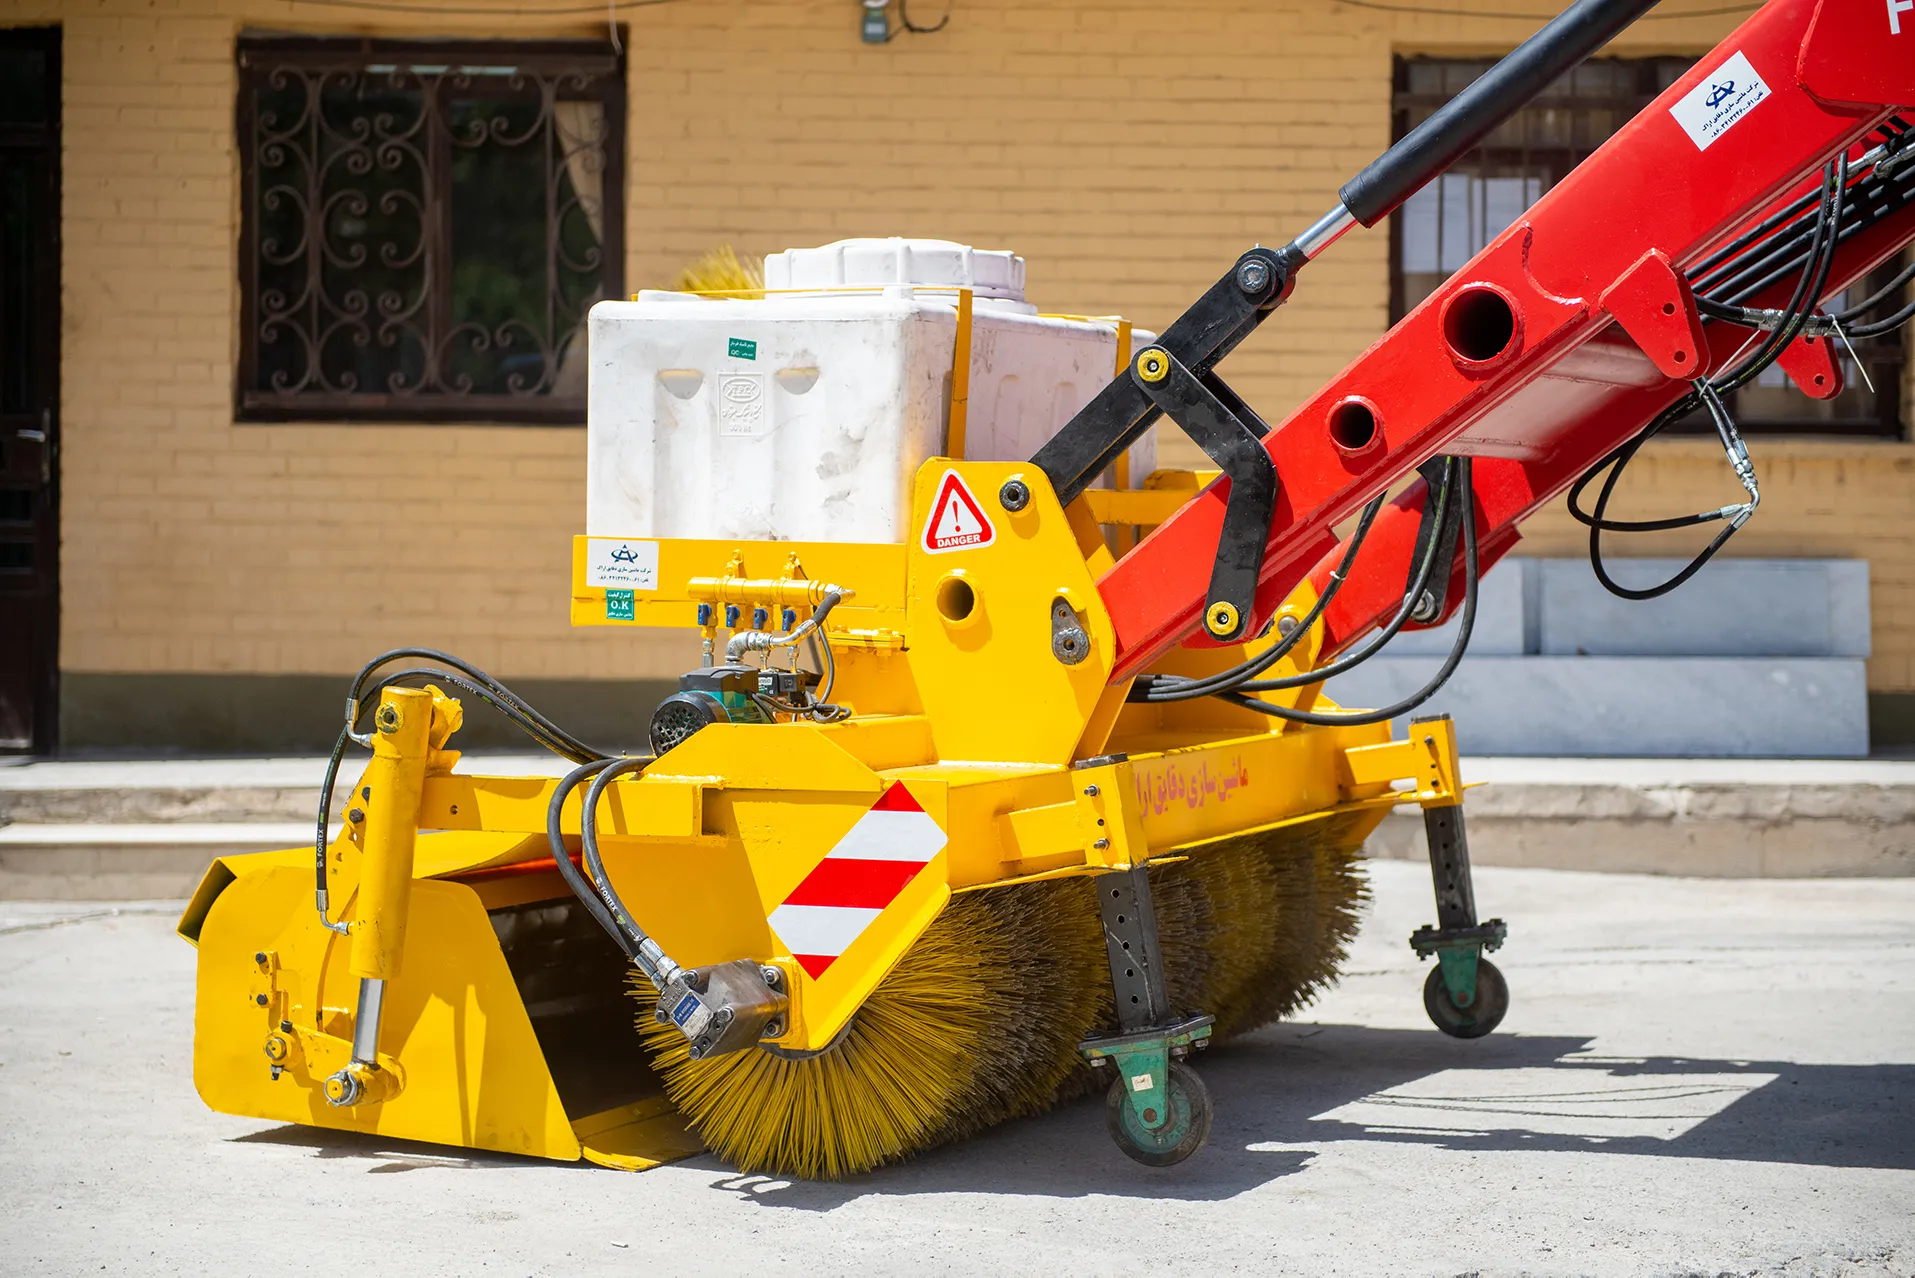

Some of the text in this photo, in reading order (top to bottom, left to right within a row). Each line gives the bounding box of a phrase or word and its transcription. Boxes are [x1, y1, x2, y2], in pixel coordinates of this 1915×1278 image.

[937, 534, 981, 548] DANGER
[610, 600, 629, 610] O.K
[453, 679, 478, 696] FORTEX
[1154, 764, 1186, 816] دقایق
[1186, 761, 1217, 809] سازی
[1218, 755, 1249, 802] ماشین
[600, 886, 618, 912] FORTEX
